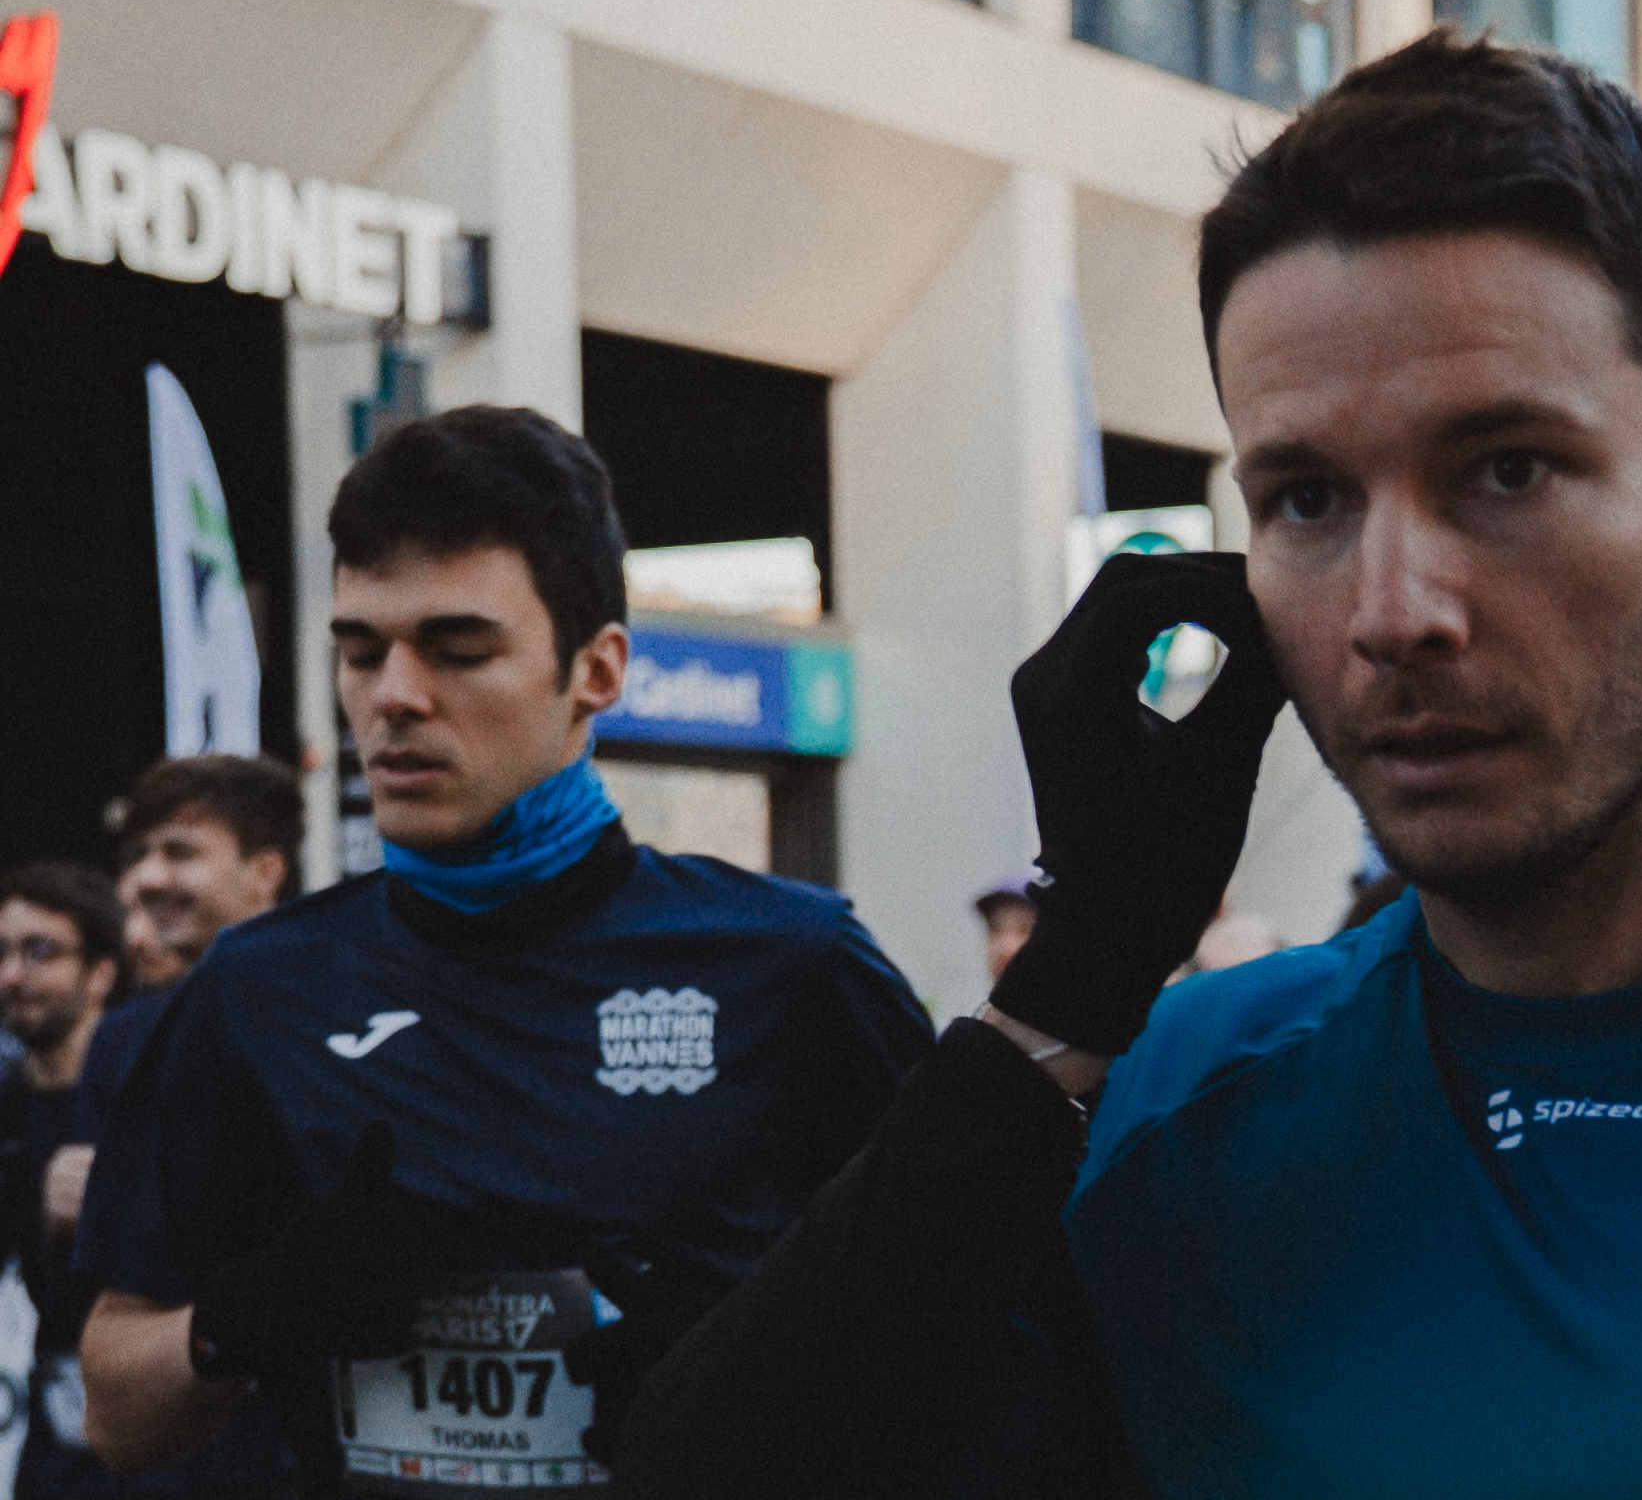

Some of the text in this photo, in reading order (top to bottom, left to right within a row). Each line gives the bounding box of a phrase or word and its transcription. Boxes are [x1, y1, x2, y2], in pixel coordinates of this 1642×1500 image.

[600, 1014, 715, 1041] MARATHON
[601, 1040, 715, 1067] VANNES
[402, 1353, 557, 1419] 1407
[431, 1426, 531, 1451] THOMAS
